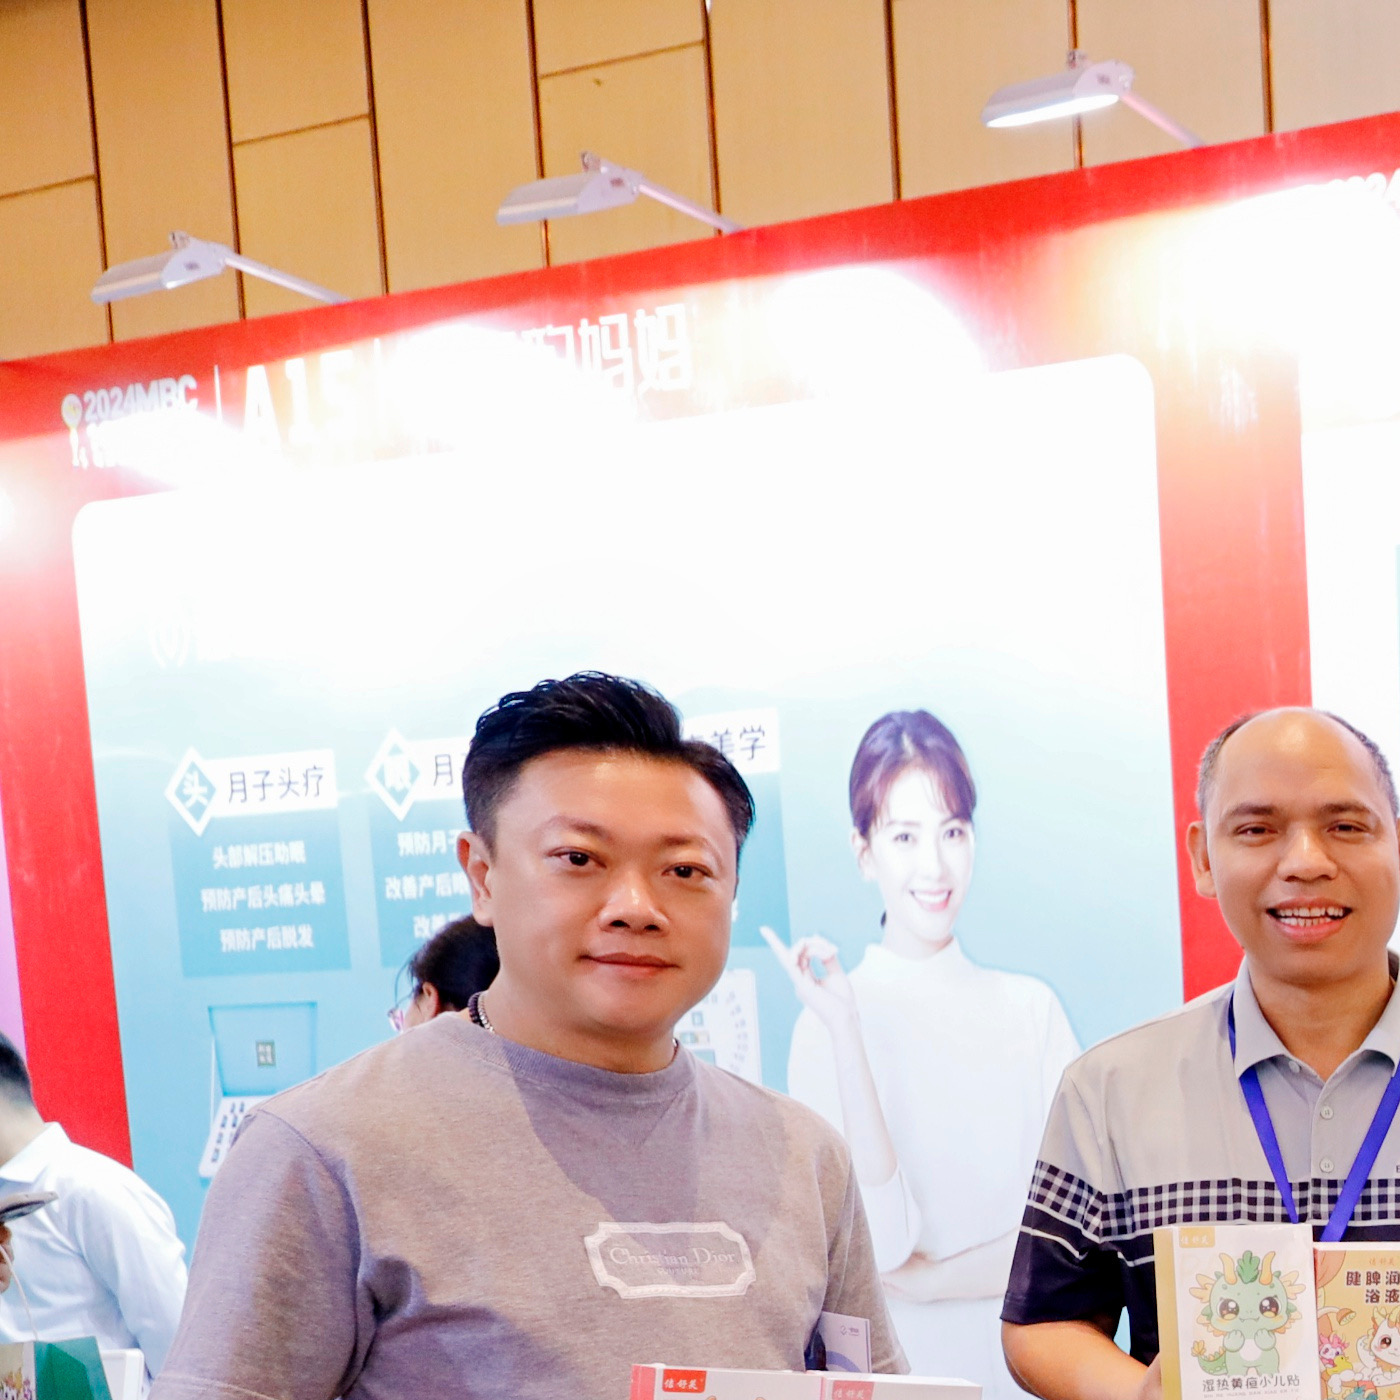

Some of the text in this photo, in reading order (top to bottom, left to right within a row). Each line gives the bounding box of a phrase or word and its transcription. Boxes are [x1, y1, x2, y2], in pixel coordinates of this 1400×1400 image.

[228, 765, 324, 804] 月子头疗
[610, 1247, 736, 1265] Christian Dior
[1365, 1288, 1400, 1304] 浴液
[1202, 1374, 1301, 1393] 湿热黄疸小儿贴
